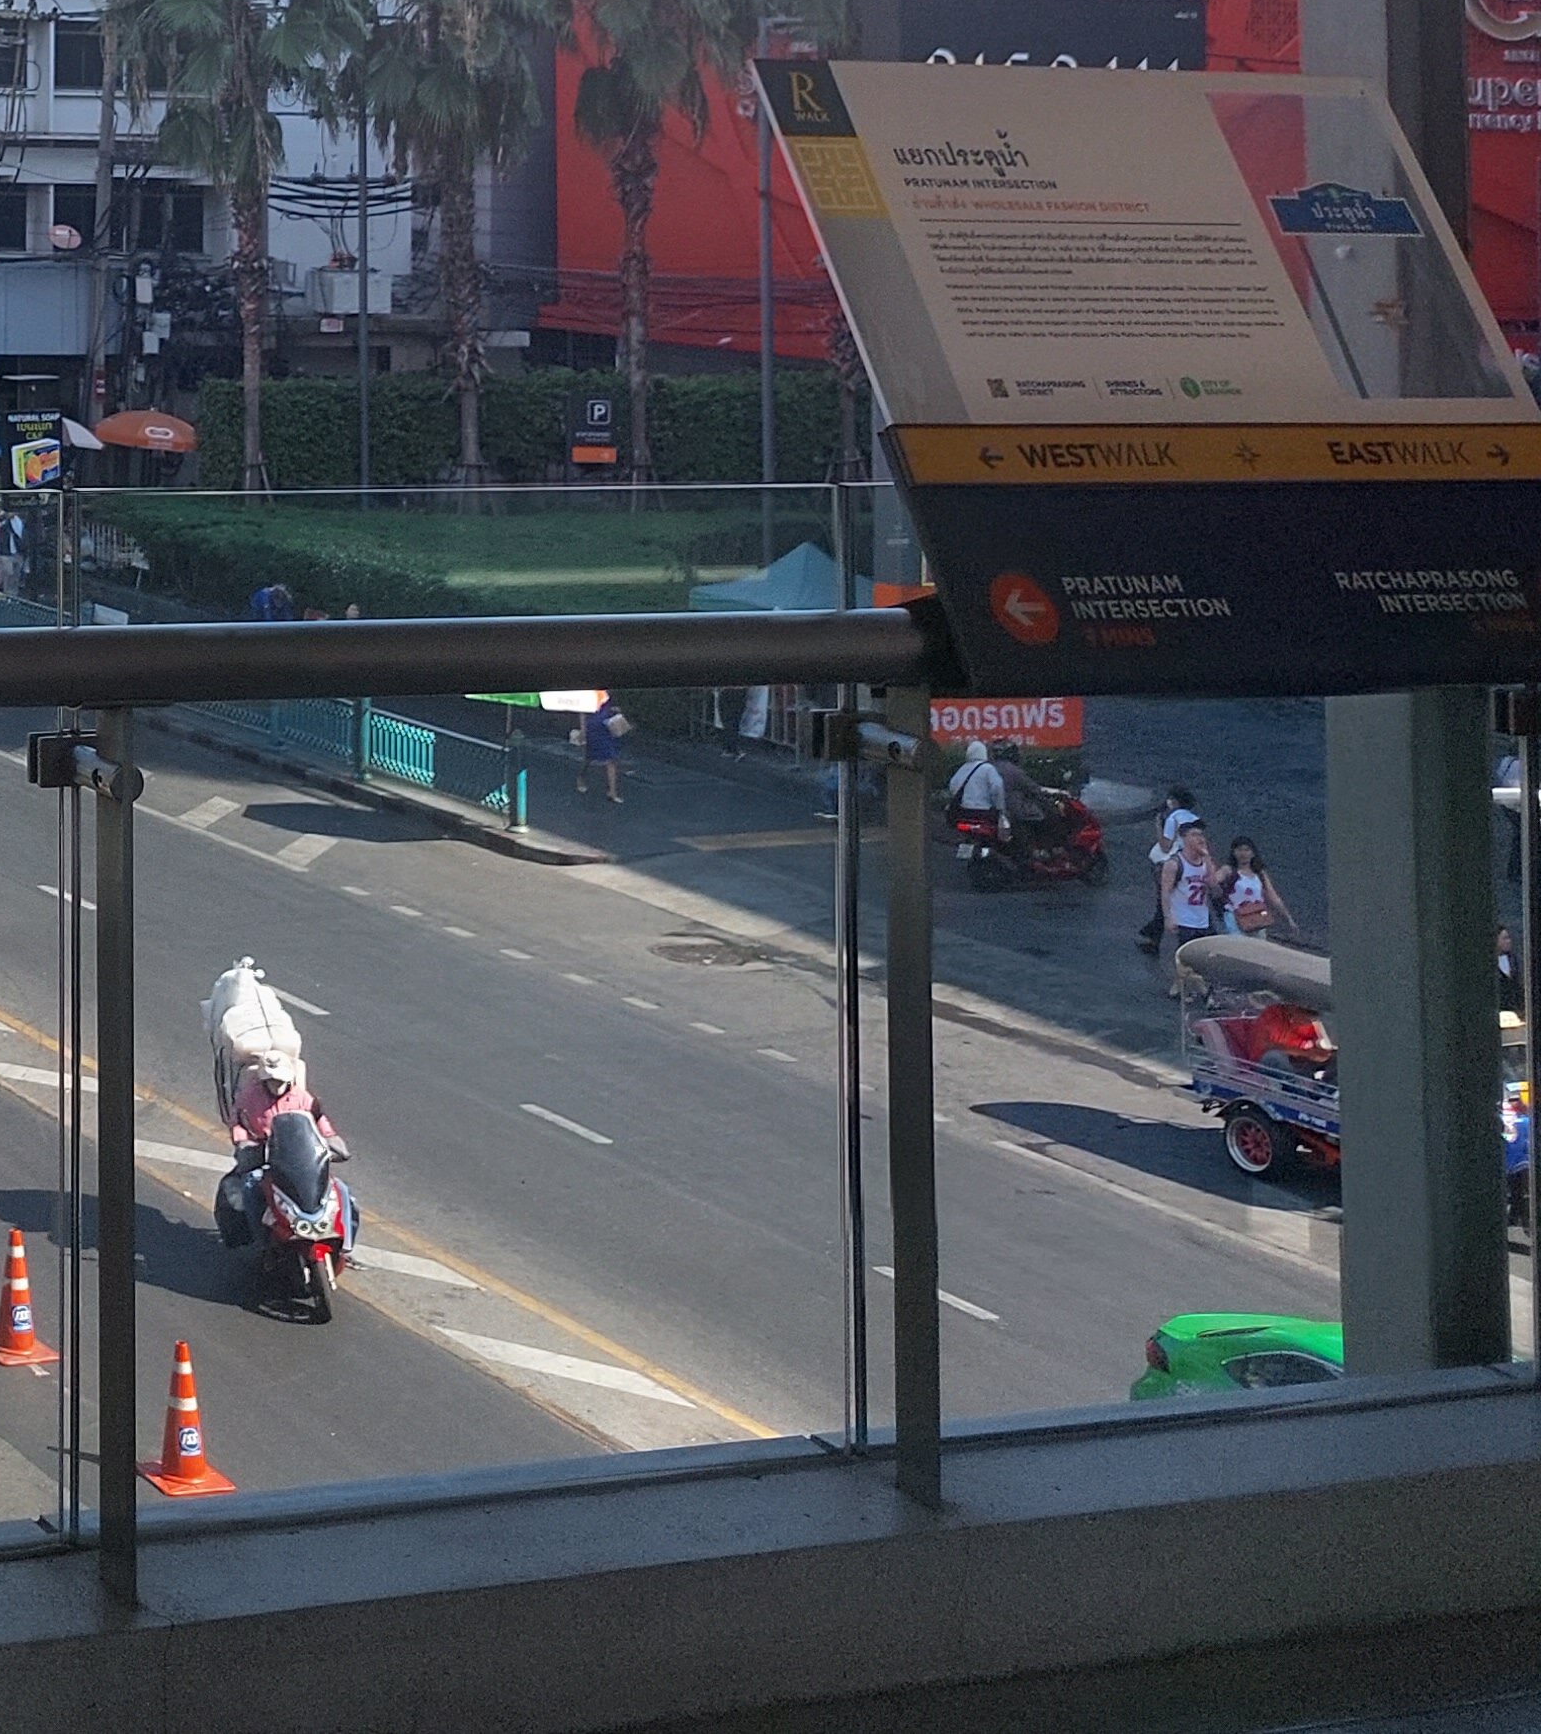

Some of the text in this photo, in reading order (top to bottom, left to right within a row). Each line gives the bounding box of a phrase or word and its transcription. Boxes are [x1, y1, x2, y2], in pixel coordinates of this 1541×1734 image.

[789, 71, 826, 112] R
[794, 112, 831, 123] WALK
[903, 177, 1058, 190] PRATUNAM INTERSECTION
[972, 200, 1043, 211] WHOLESALE
[1046, 200, 1096, 212] FASHION
[1099, 202, 1150, 213] DISTRICT
[593, 404, 606, 421] P
[1017, 443, 1178, 469] WESTWALK
[1326, 440, 1471, 466] EASTWALK
[1061, 574, 1184, 597] PRATUNAM
[1334, 568, 1520, 591] RATCHAPRASONG
[1070, 597, 1232, 620] INTERSECTION
[1377, 592, 1529, 614] INTERSECTION
